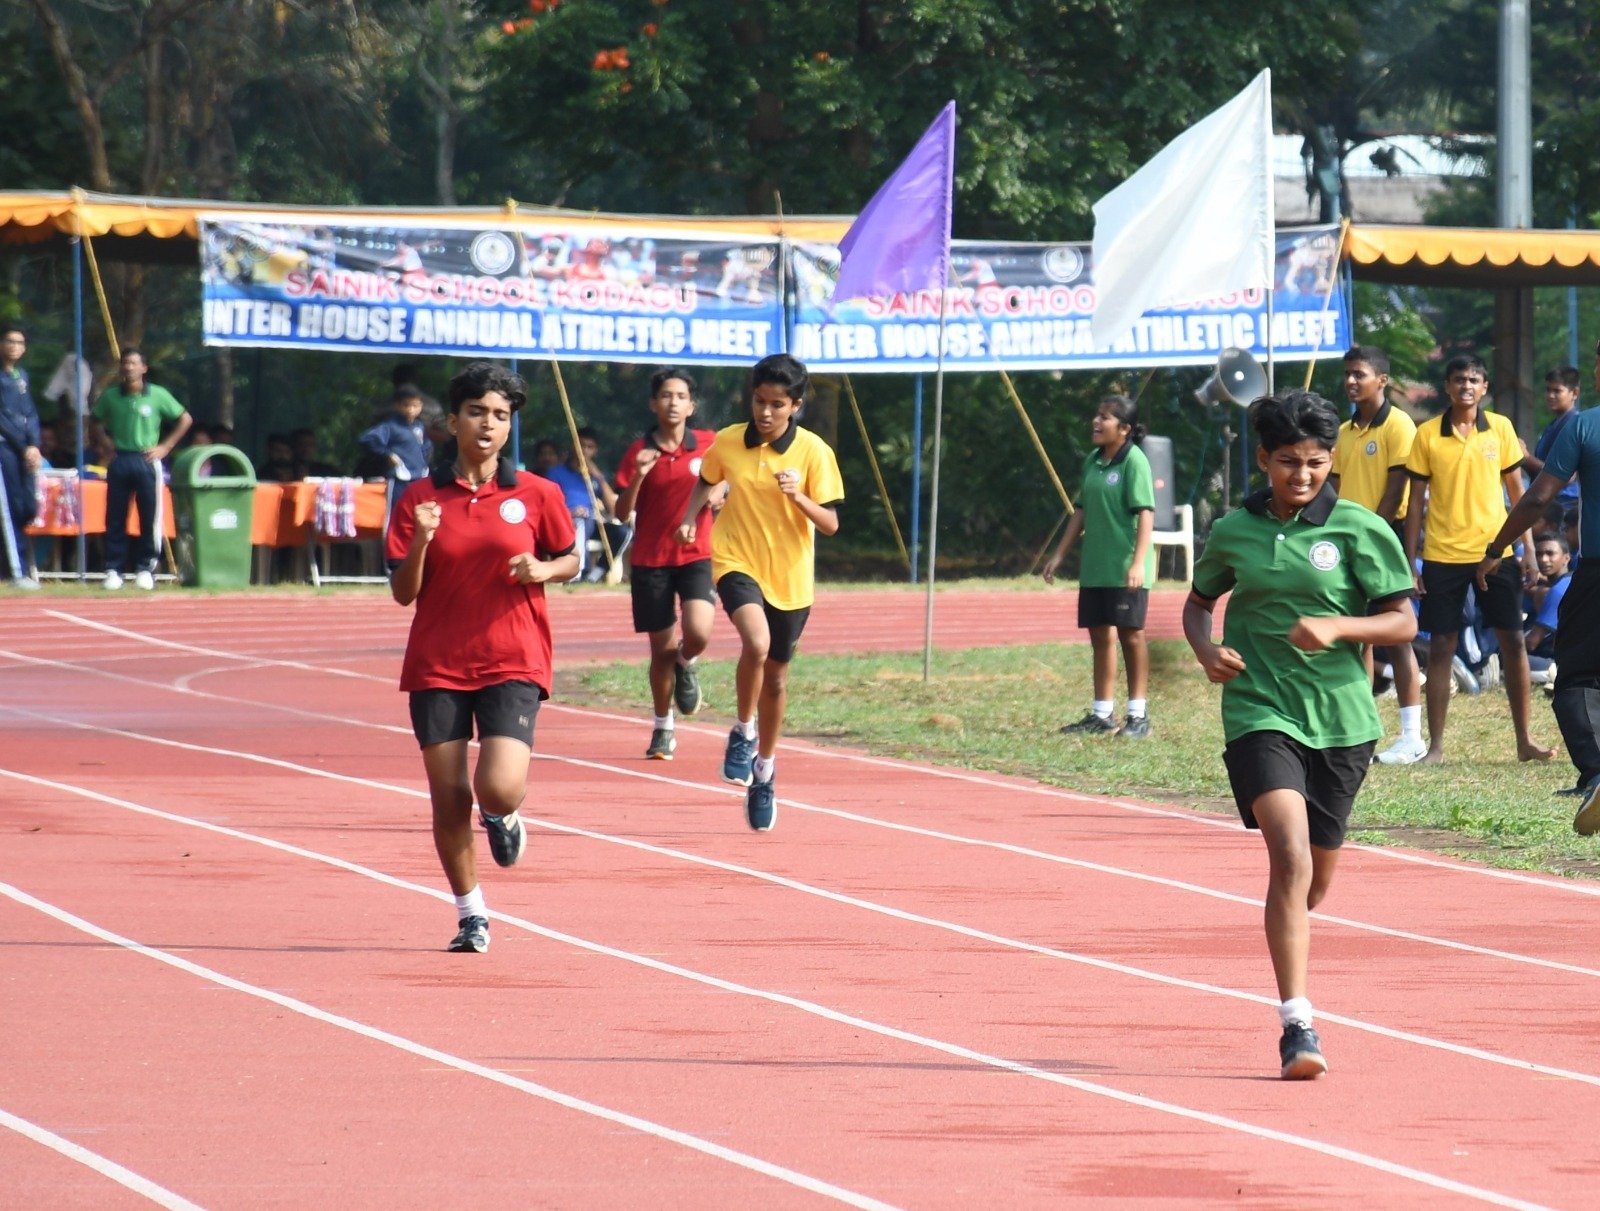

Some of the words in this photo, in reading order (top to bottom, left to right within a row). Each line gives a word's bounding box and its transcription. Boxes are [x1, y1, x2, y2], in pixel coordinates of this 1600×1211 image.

[286, 268, 398, 299] SAINIK
[981, 285, 1097, 319] SCHOO
[204, 298, 291, 336] INTER
[297, 304, 406, 342] HOUSE
[412, 309, 536, 348] ANNUAL
[540, 313, 685, 353] ATHLETIC
[690, 318, 771, 356] MEET
[881, 322, 986, 358] HOUSE
[990, 317, 1110, 356] ANNUA
[1258, 310, 1340, 348] MEET
